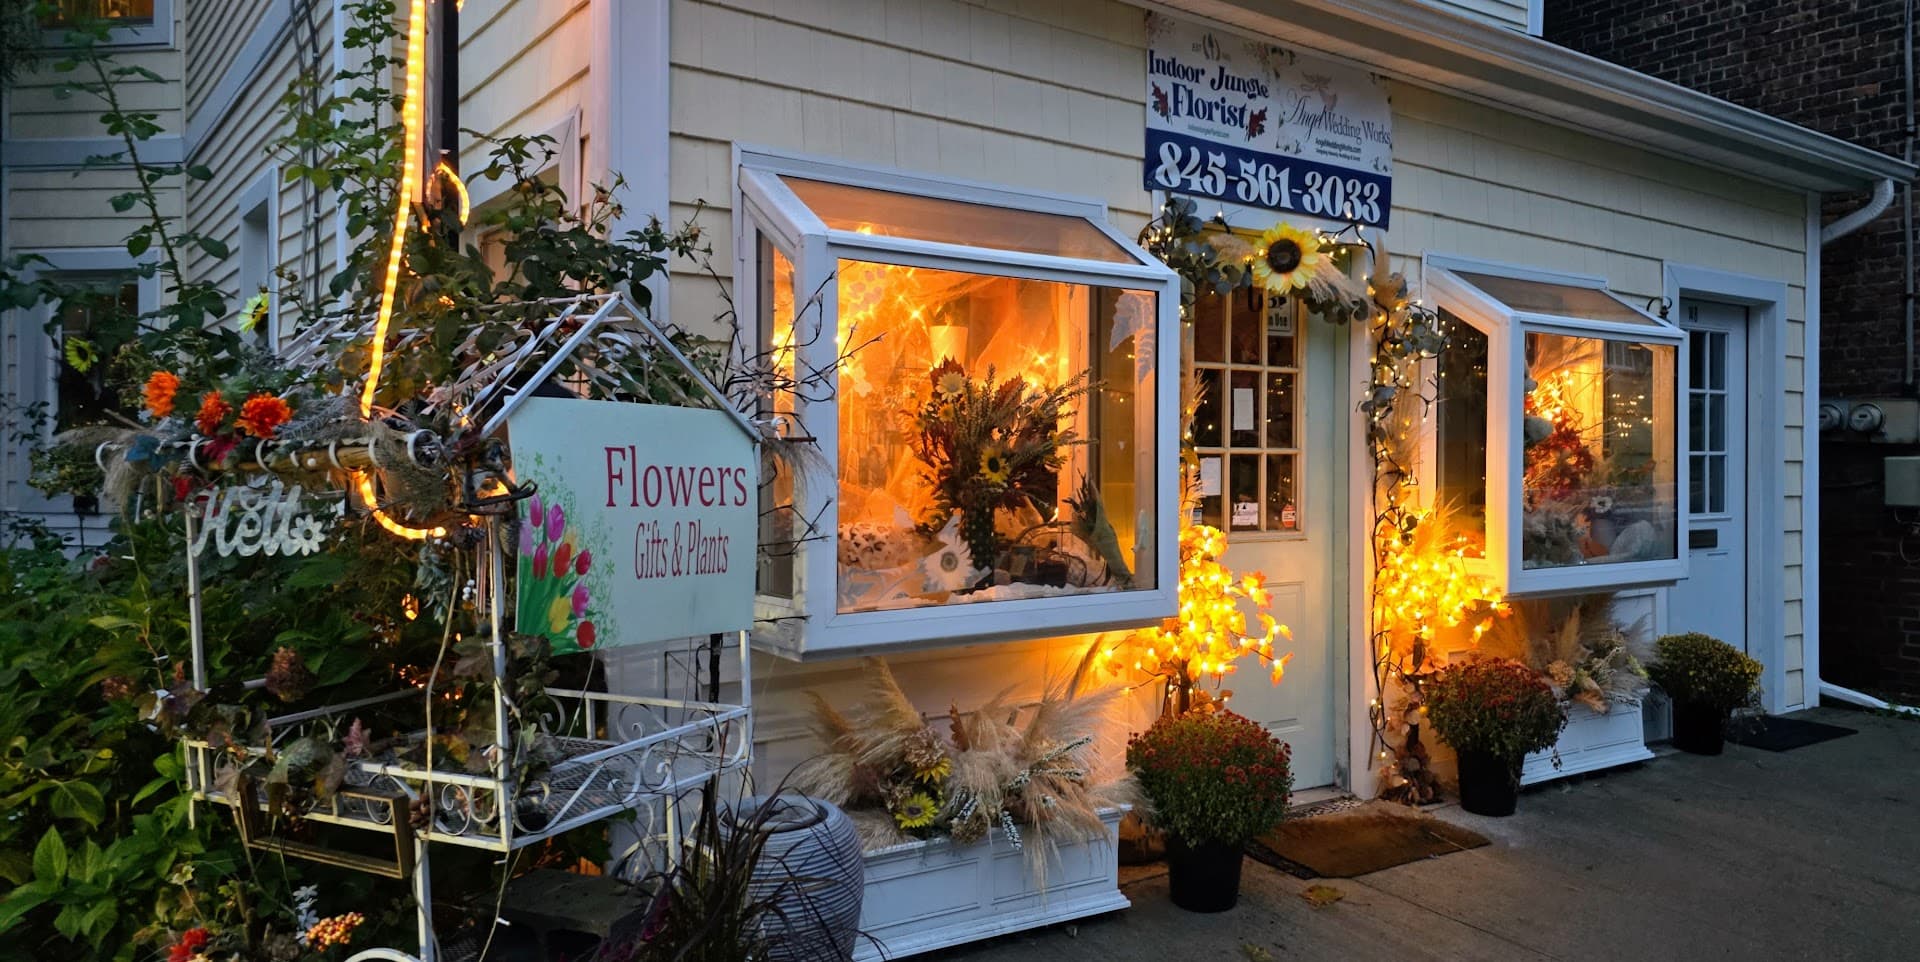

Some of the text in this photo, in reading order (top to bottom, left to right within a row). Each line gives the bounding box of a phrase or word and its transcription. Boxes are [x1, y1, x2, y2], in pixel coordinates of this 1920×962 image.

[1148, 49, 1269, 100] Indoor Jungle
[1172, 82, 1248, 129] Florist
[1324, 107, 1362, 145] Wedding
[1361, 119, 1391, 145] Works
[1155, 141, 1381, 223] 845-561-3033
[604, 445, 748, 508] Flowers
[635, 518, 729, 580] Gifts & Plants
